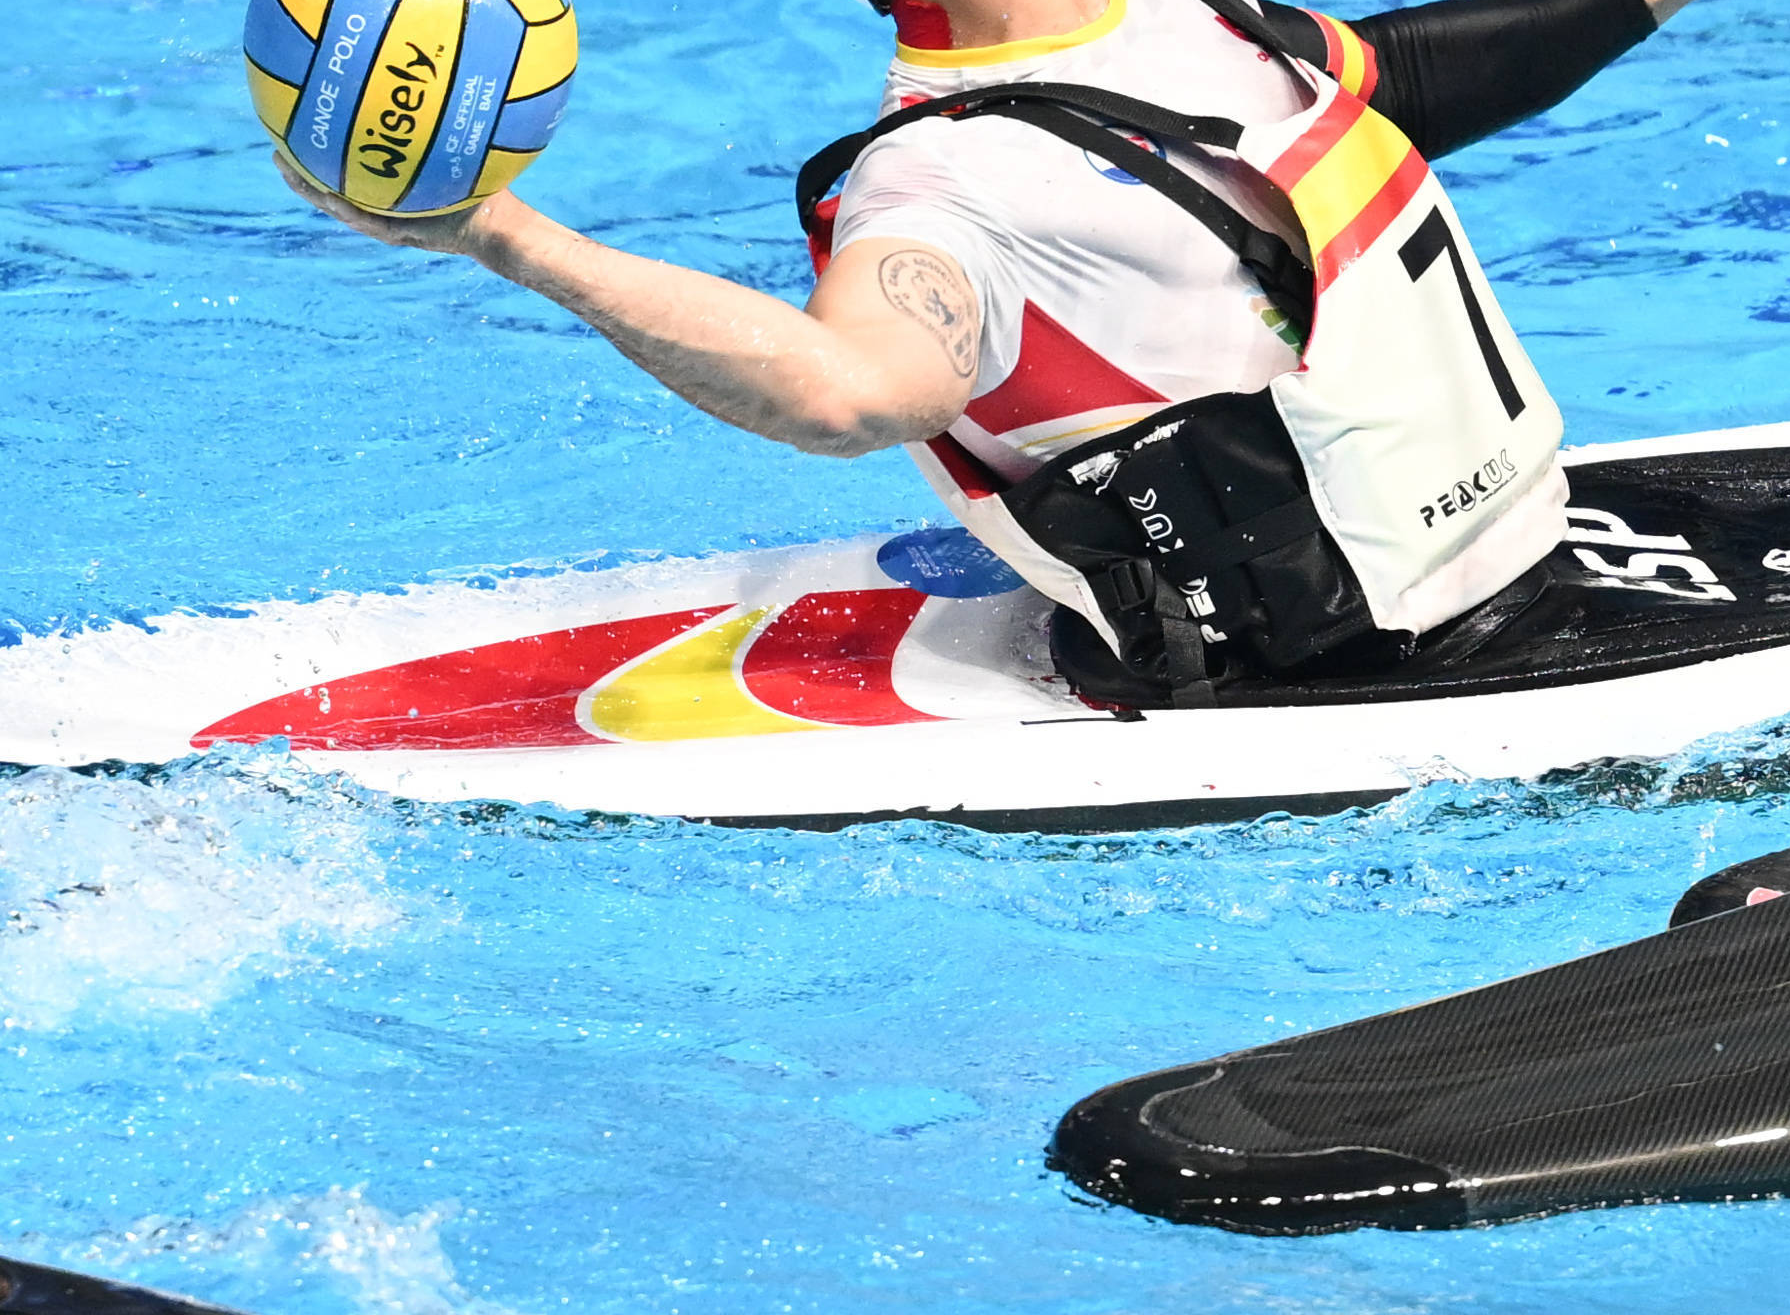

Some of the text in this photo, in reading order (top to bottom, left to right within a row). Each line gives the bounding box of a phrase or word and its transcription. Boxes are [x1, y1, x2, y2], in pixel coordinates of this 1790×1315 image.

[310, 14, 367, 149] CANOE POLO
[359, 41, 437, 178] Wisely
[453, 75, 480, 131] OFFICIAL
[463, 78, 497, 156] GAME BALL
[1397, 204, 1526, 422] 7
[1563, 506, 1738, 602] ESP
